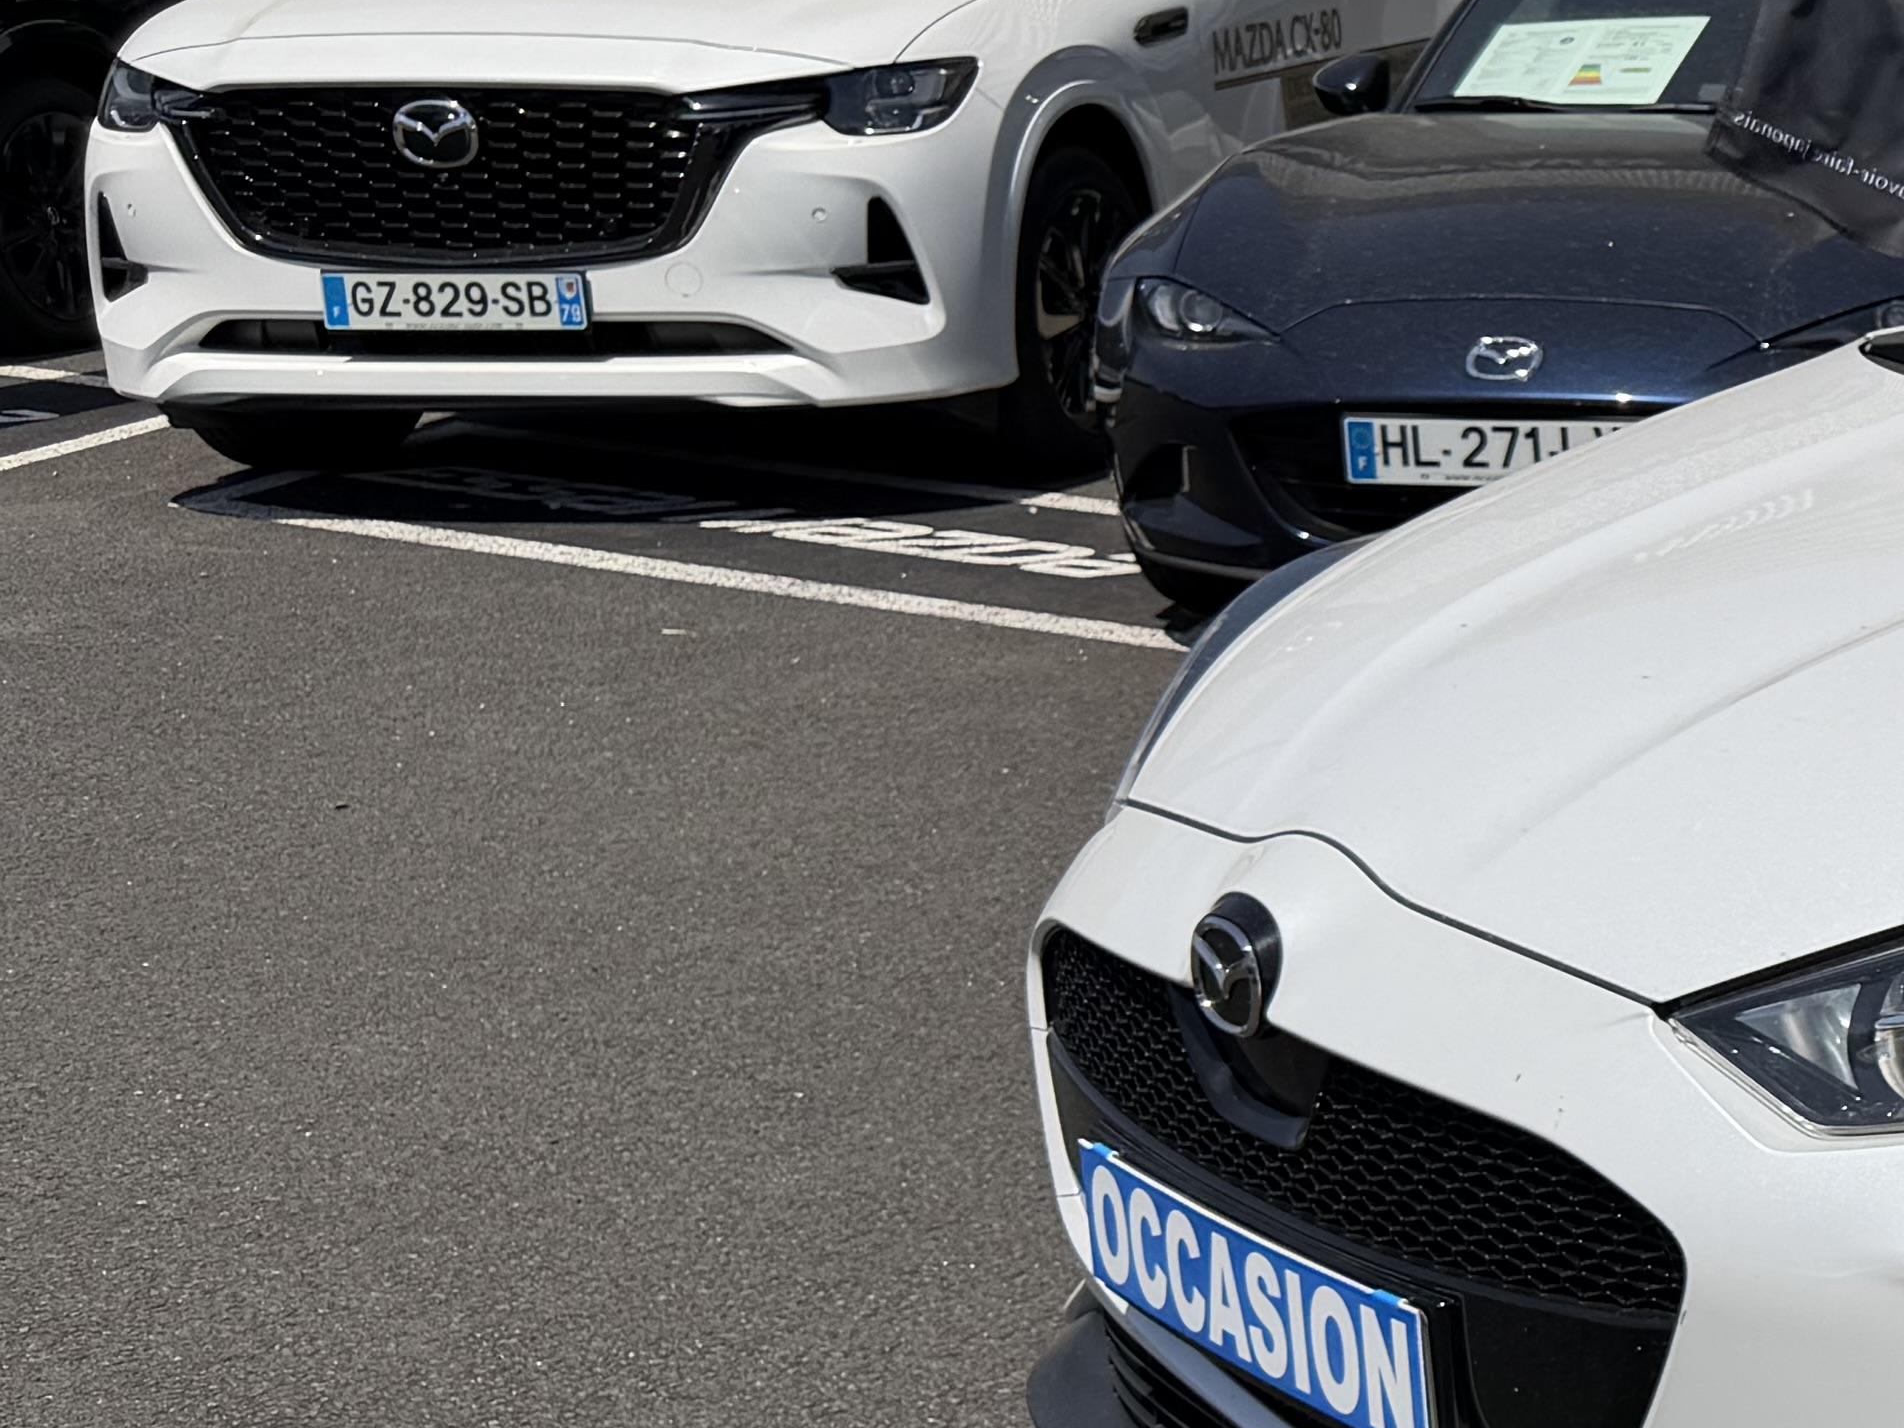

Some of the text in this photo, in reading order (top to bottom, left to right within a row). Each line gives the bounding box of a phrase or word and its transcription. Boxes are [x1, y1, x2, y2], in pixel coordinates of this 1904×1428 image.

[1212, 8, 1343, 75] MAZDA CX-80
[350, 281, 552, 318] GZ-829-SB
[560, 303, 582, 323] 79
[1358, 457, 1368, 471] F
